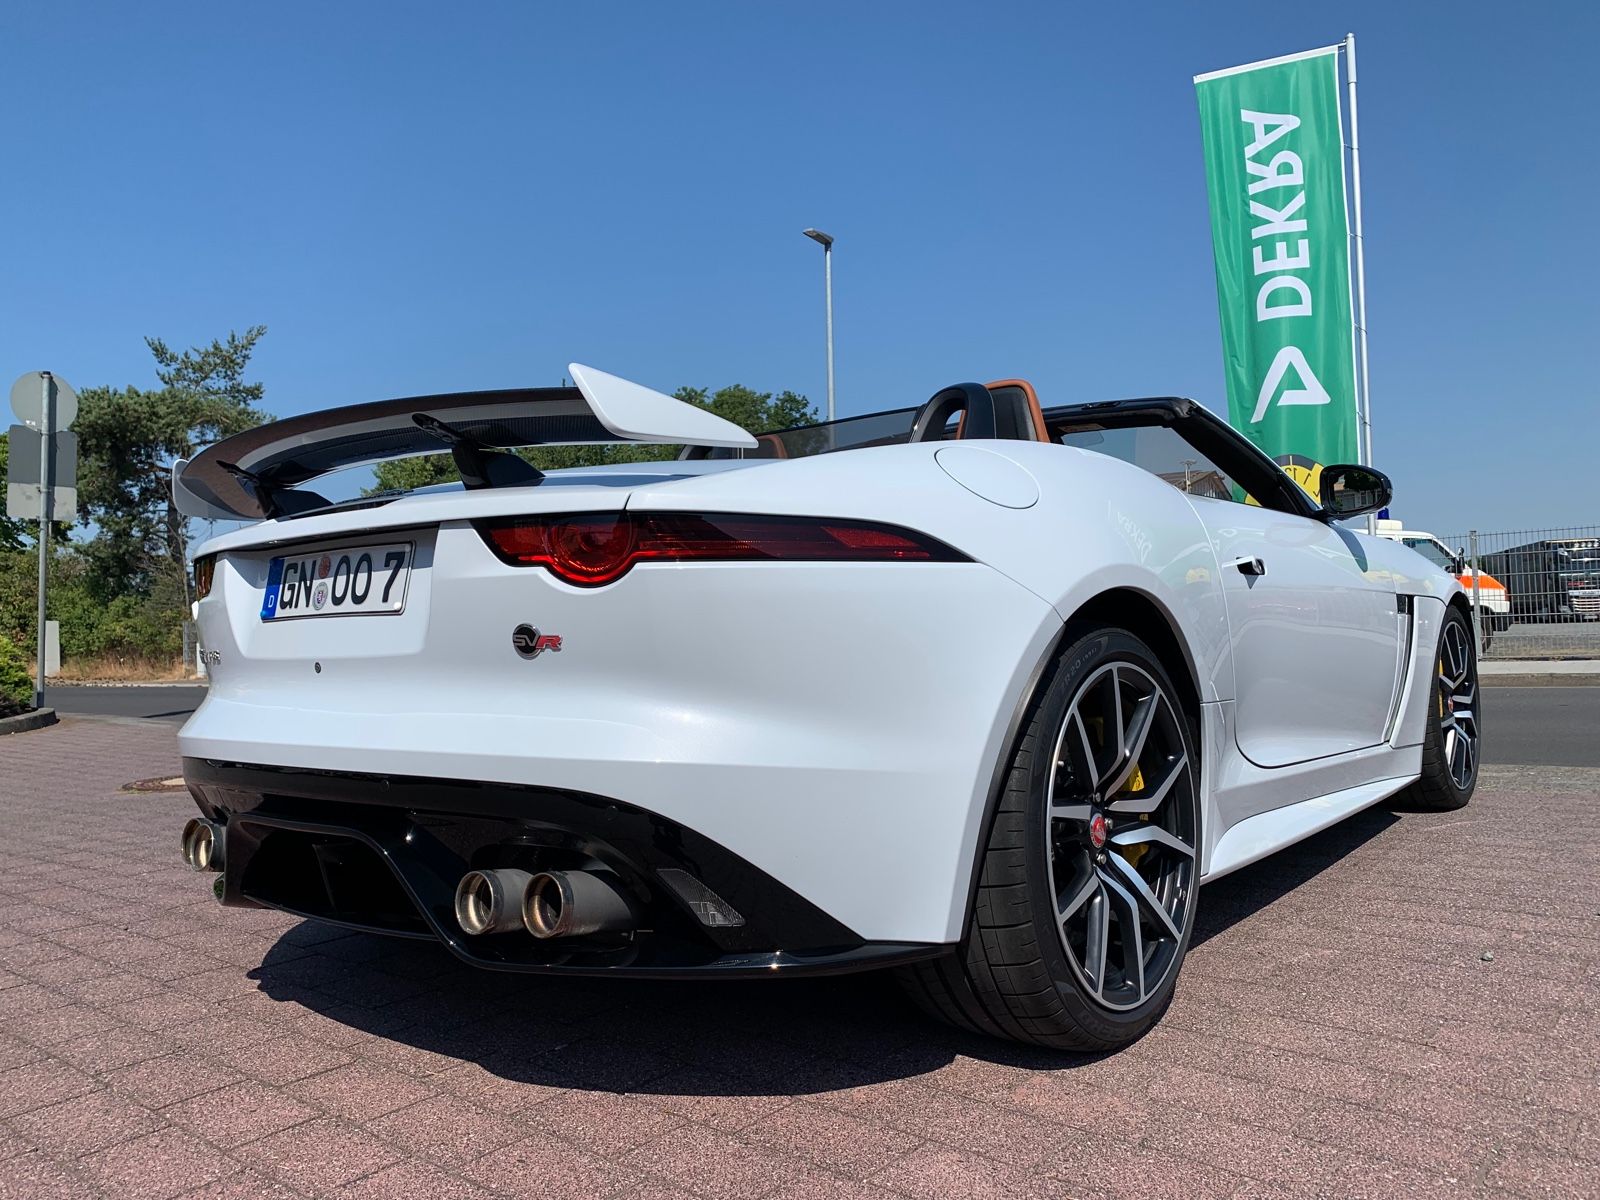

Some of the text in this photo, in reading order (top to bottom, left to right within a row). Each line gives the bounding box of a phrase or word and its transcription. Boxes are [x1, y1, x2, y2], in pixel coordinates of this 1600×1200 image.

[279, 559, 316, 610] GN
[268, 595, 275, 608] D
[513, 634, 562, 652] SVR
